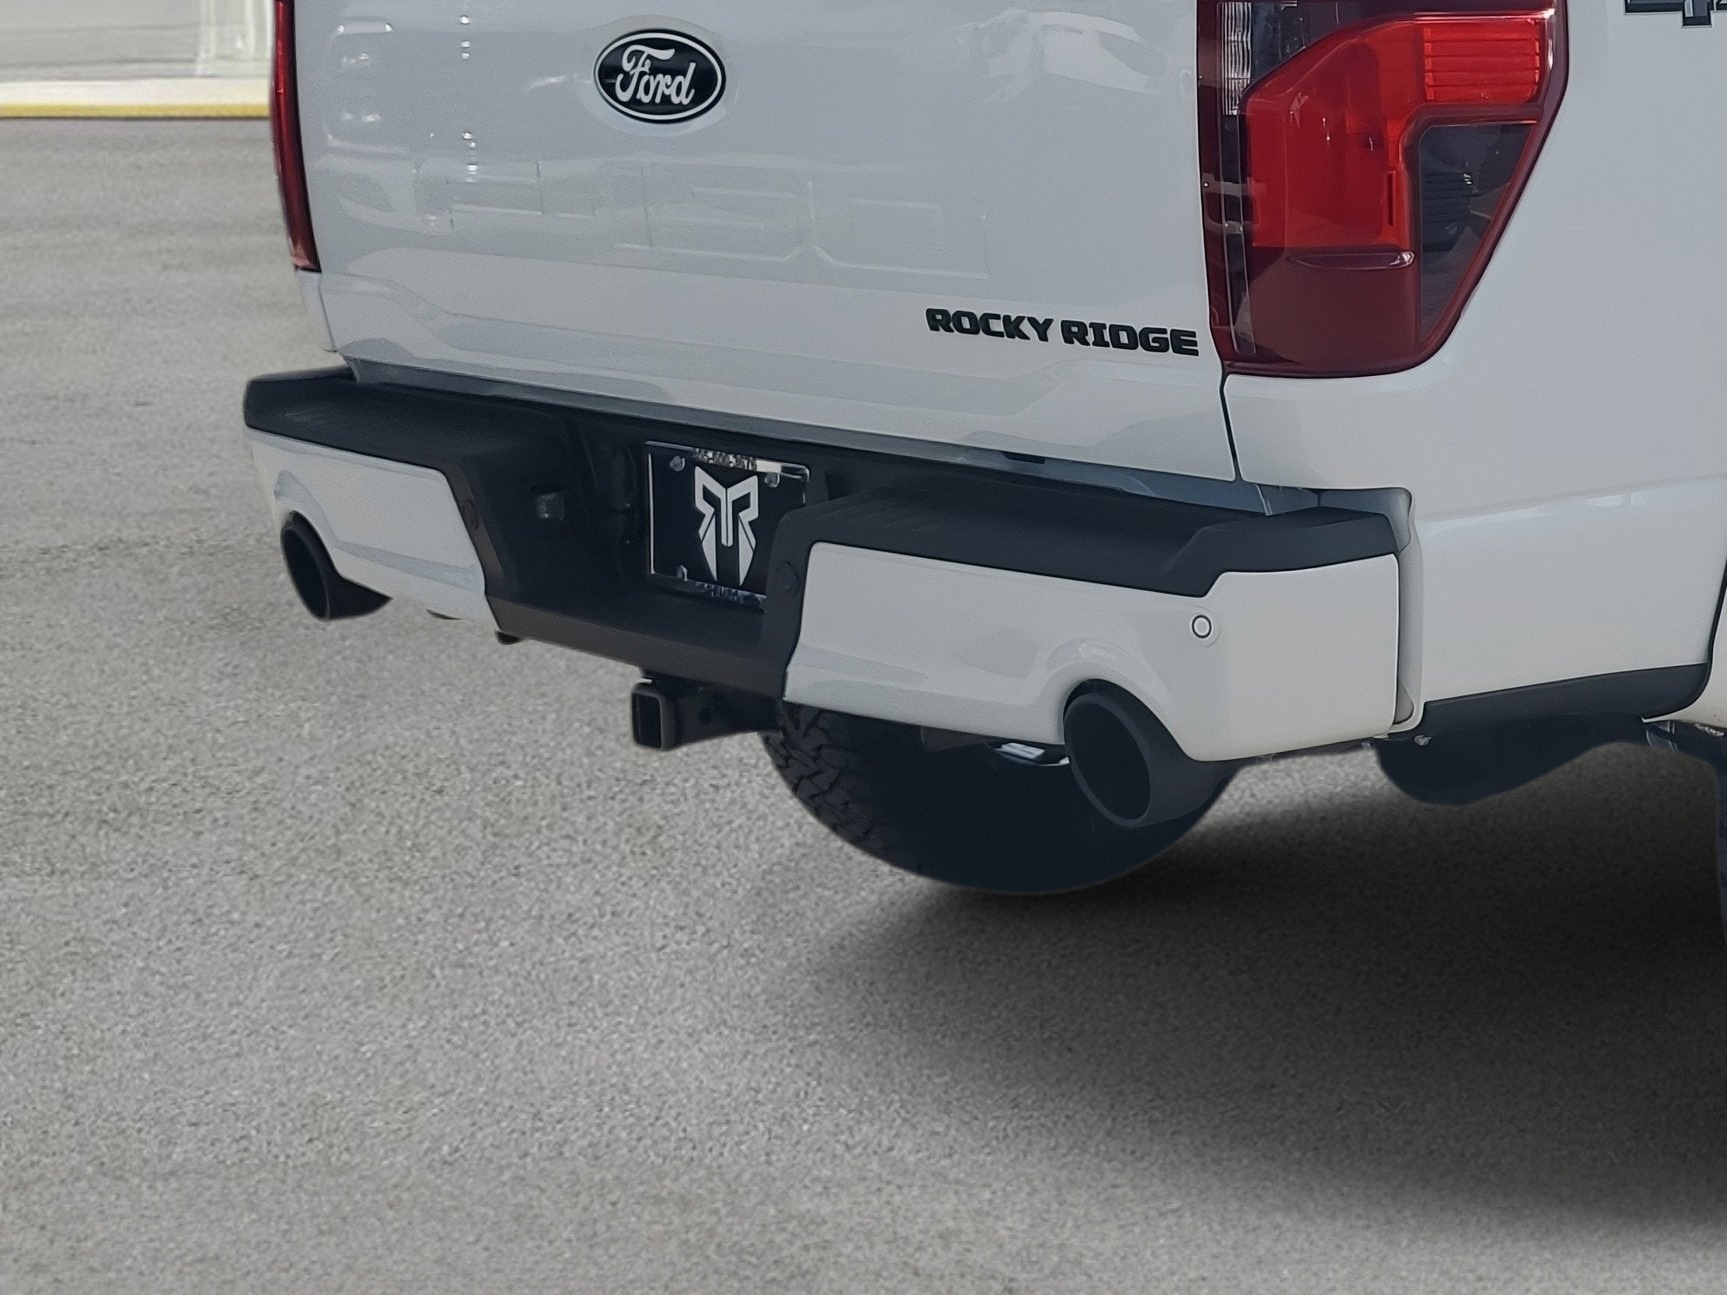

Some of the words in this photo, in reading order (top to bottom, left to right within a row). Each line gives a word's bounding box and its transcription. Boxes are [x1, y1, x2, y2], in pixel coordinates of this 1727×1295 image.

[615, 44, 696, 105] Ford
[925, 308, 1054, 342] ROCKY
[1060, 319, 1200, 356] RIDGE
